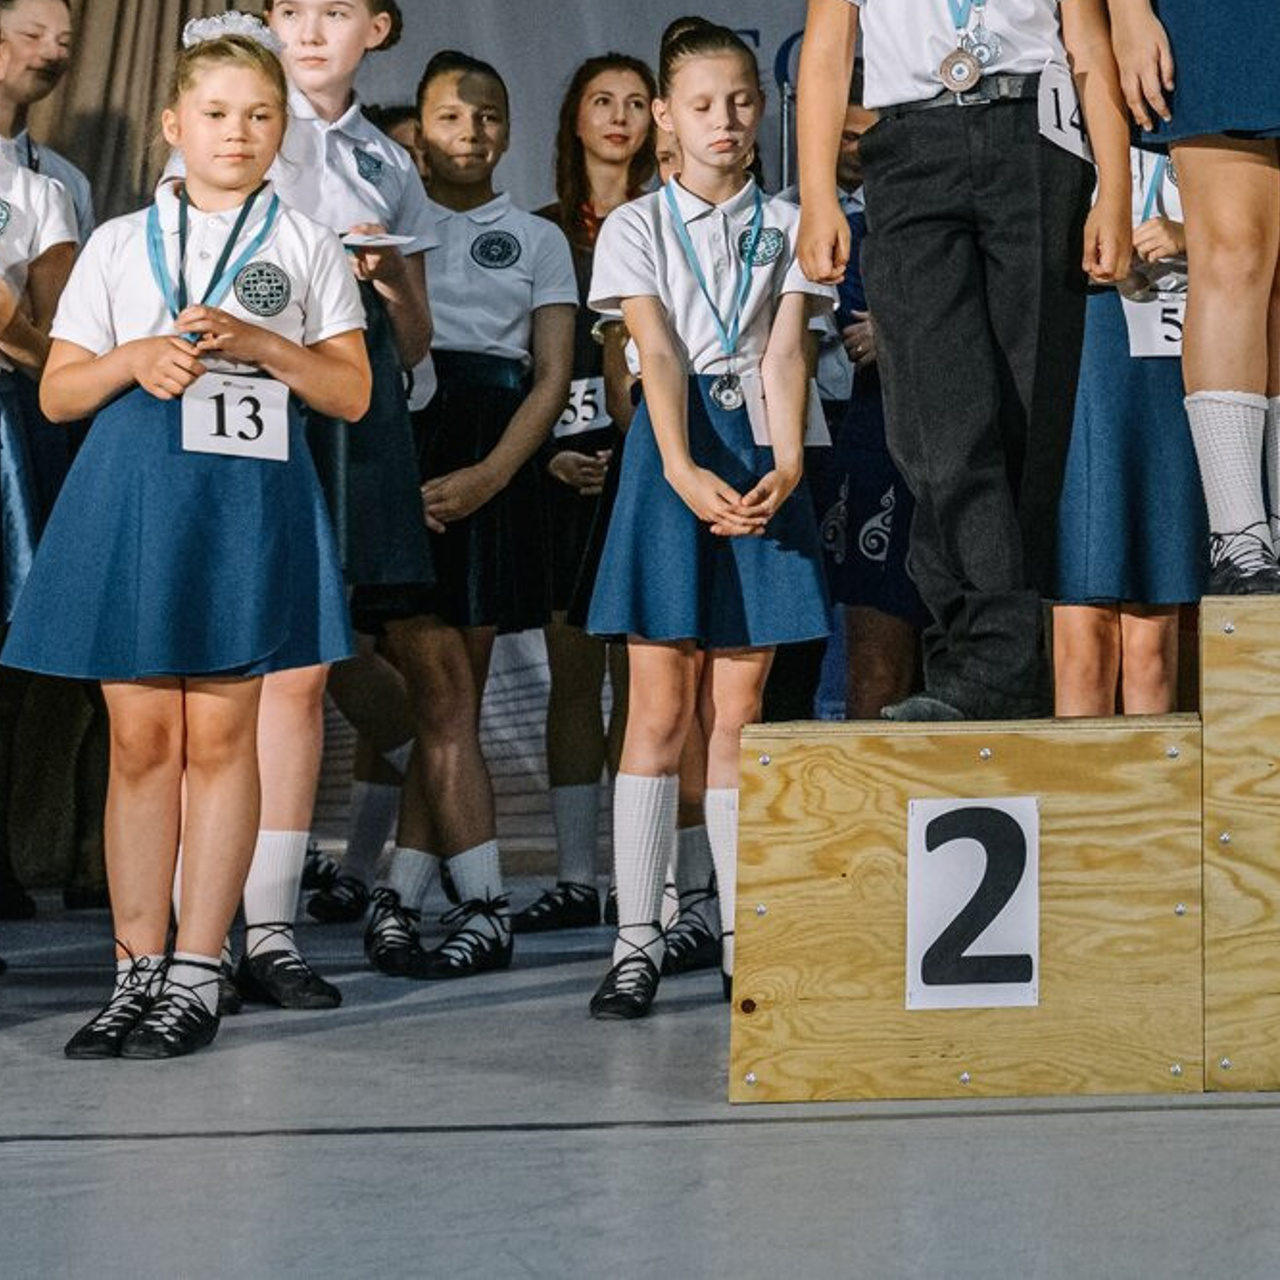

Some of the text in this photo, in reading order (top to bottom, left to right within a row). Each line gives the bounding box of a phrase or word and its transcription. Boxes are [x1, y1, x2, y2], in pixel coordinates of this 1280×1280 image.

[208, 393, 264, 441] 13
[560, 388, 598, 425] 55
[920, 806, 1034, 986] 2
